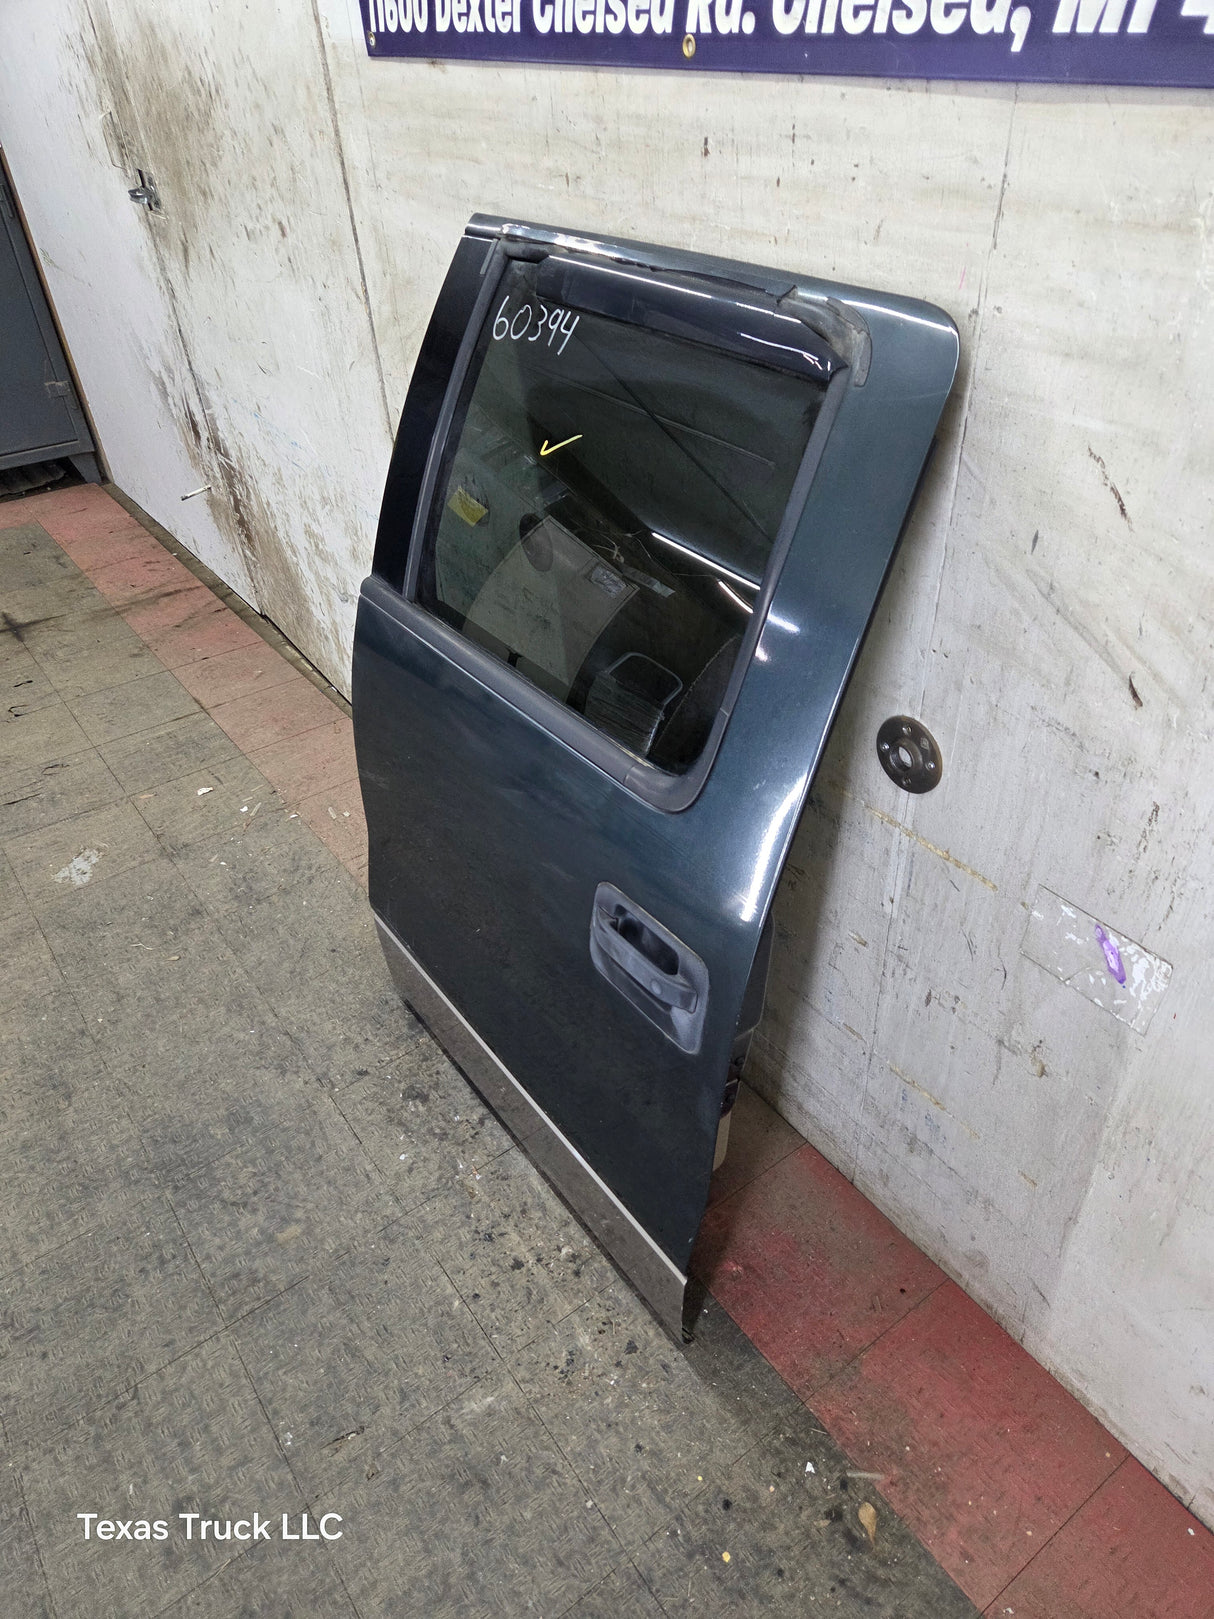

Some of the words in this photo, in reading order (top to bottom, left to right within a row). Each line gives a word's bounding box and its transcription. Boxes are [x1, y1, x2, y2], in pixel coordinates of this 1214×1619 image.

[435, 0, 521, 33] Dexter
[532, 0, 675, 34] Chelsea
[685, 0, 756, 35] Rd.
[492, 295, 580, 355] 60394
